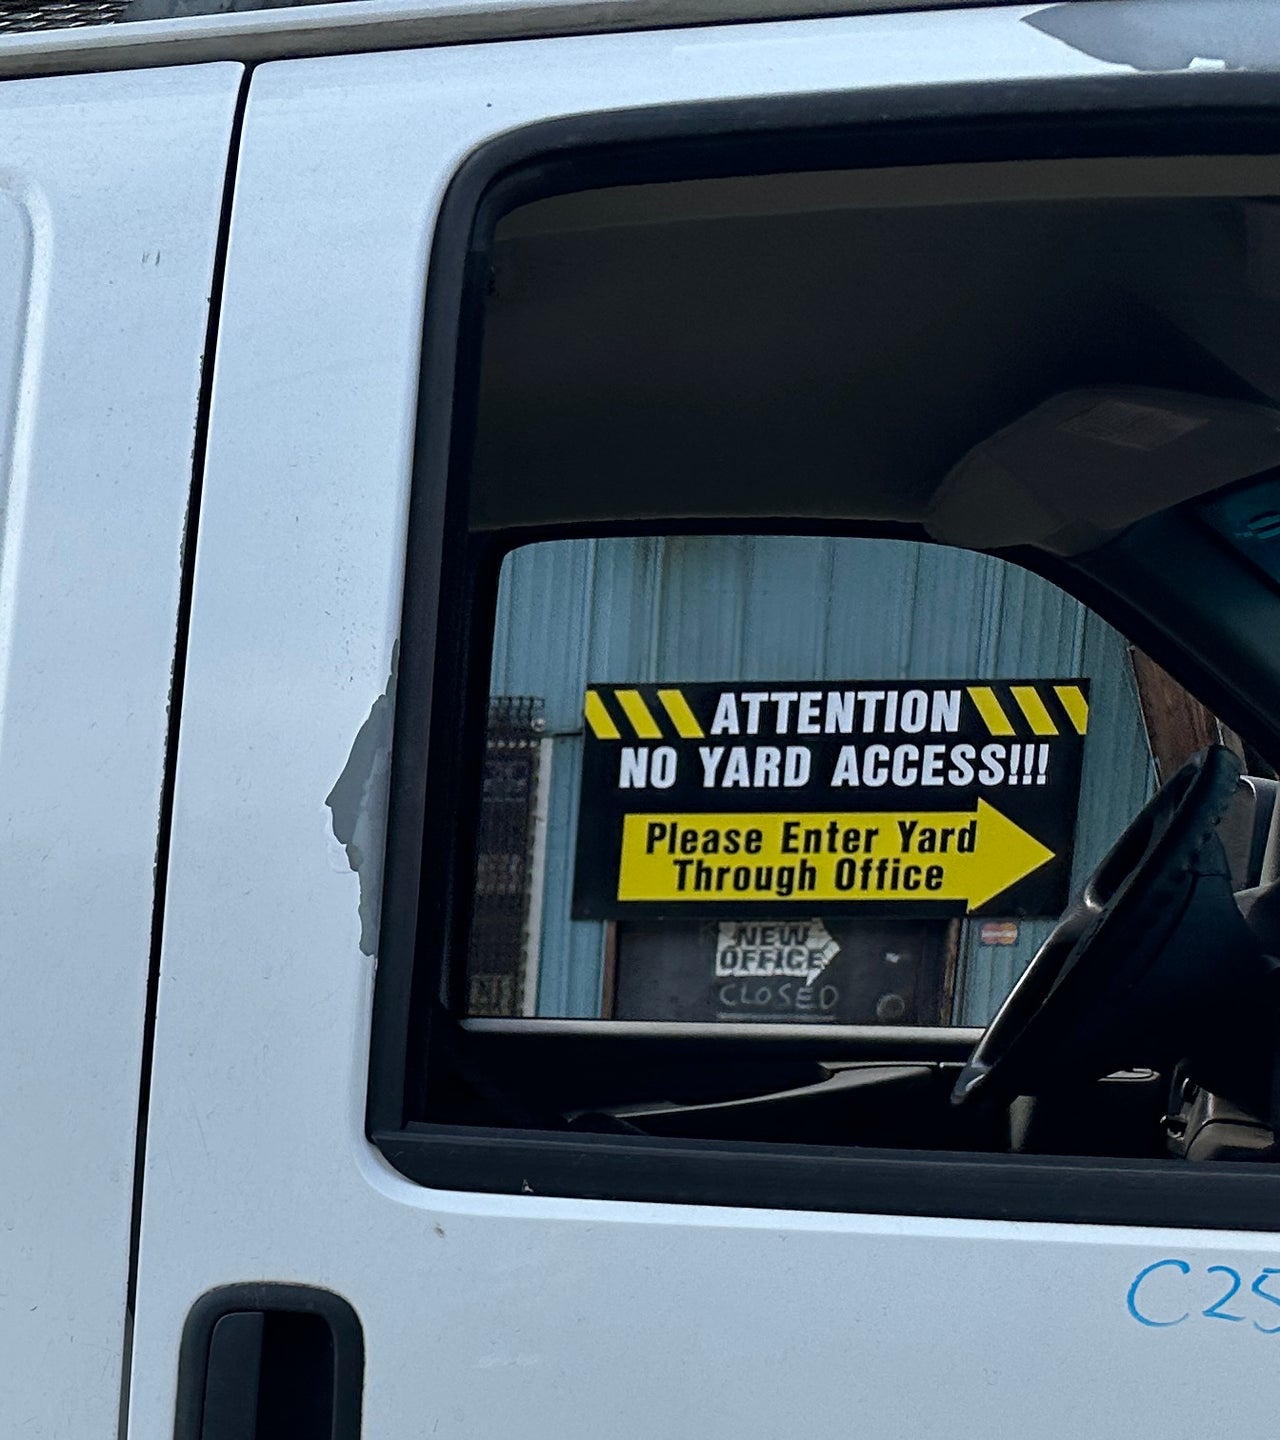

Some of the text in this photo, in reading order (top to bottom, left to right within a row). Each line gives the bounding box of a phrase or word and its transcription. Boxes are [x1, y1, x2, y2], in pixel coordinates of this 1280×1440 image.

[709, 689, 962, 736] ATTENTION
[618, 743, 1050, 789] NO YARD ACCESS!!!
[646, 820, 978, 855] Please Enter Yard
[673, 857, 944, 897] Through Office
[739, 926, 810, 946] NEW
[720, 946, 825, 970] OFFICE
[719, 982, 839, 1010] CLOSED
